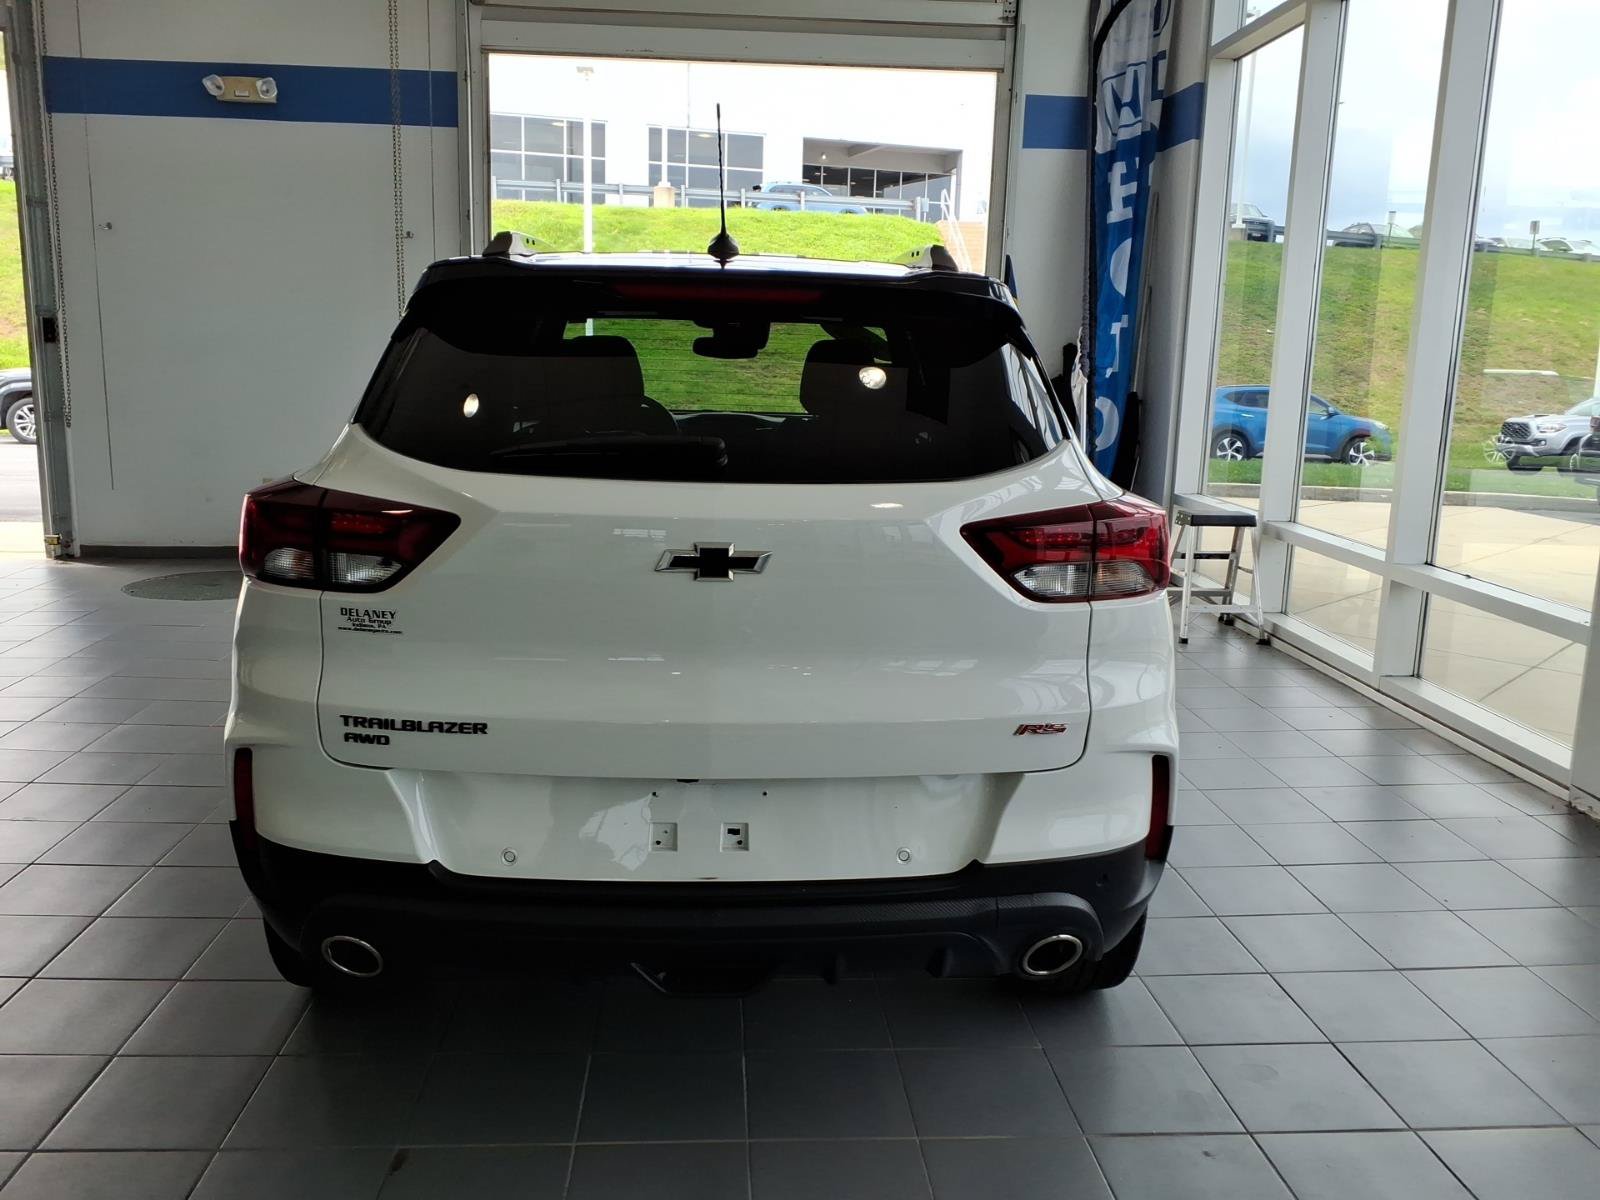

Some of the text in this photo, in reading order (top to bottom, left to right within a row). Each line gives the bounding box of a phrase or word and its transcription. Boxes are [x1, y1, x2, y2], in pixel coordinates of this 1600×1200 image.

[340, 607, 397, 620] DELANEY
[339, 714, 488, 735] TRAILBLAZER
[1012, 723, 1067, 736] RS
[343, 732, 390, 746] AWD
